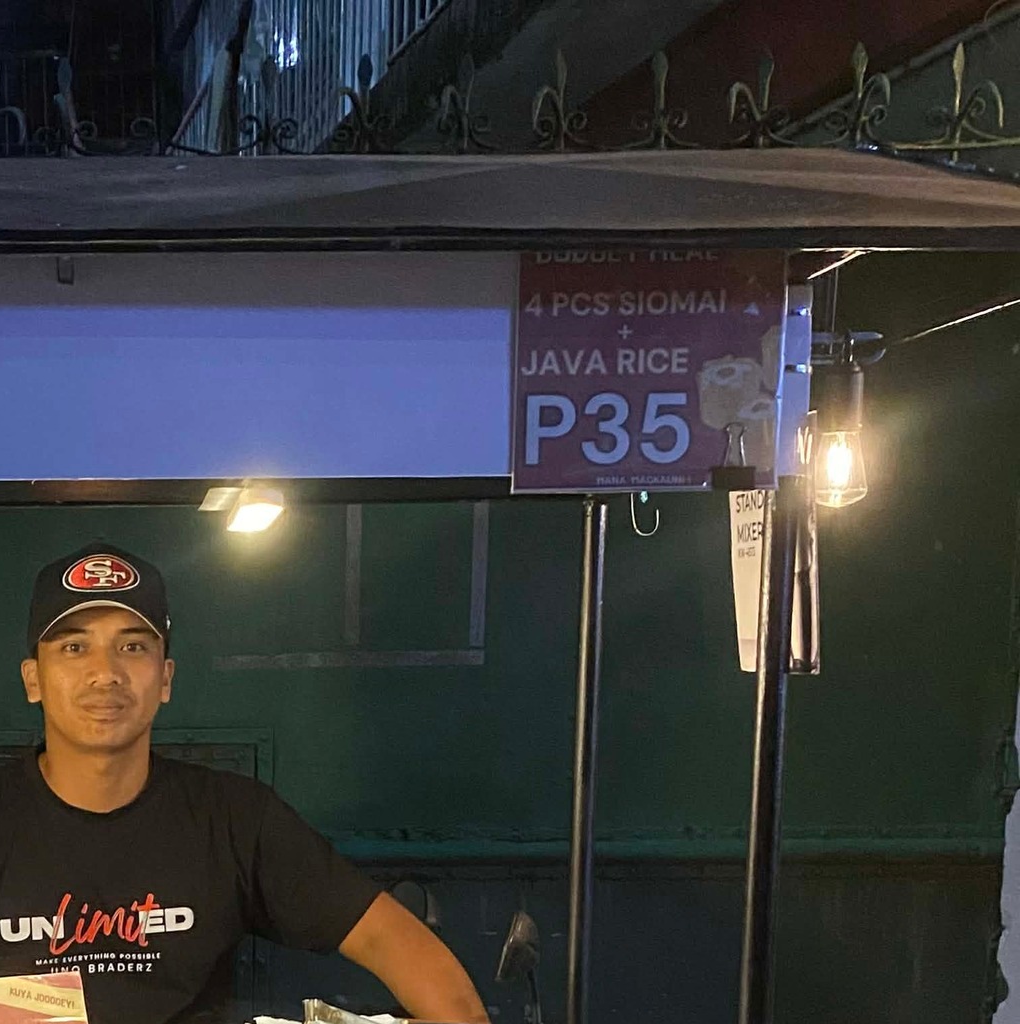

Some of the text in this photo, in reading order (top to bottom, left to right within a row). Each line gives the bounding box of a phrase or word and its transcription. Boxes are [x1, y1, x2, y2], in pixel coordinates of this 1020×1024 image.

[525, 289, 727, 317] 4 PCS SIOMAI
[521, 347, 690, 376] JAVA RICE
[524, 391, 691, 466] P35
[736, 490, 765, 513] STAND
[35, 951, 162, 966] MAKE EVERYTHING POSSIBLE
[87, 962, 154, 975] BRADERZ
[9, 986, 33, 1000] KUYA
